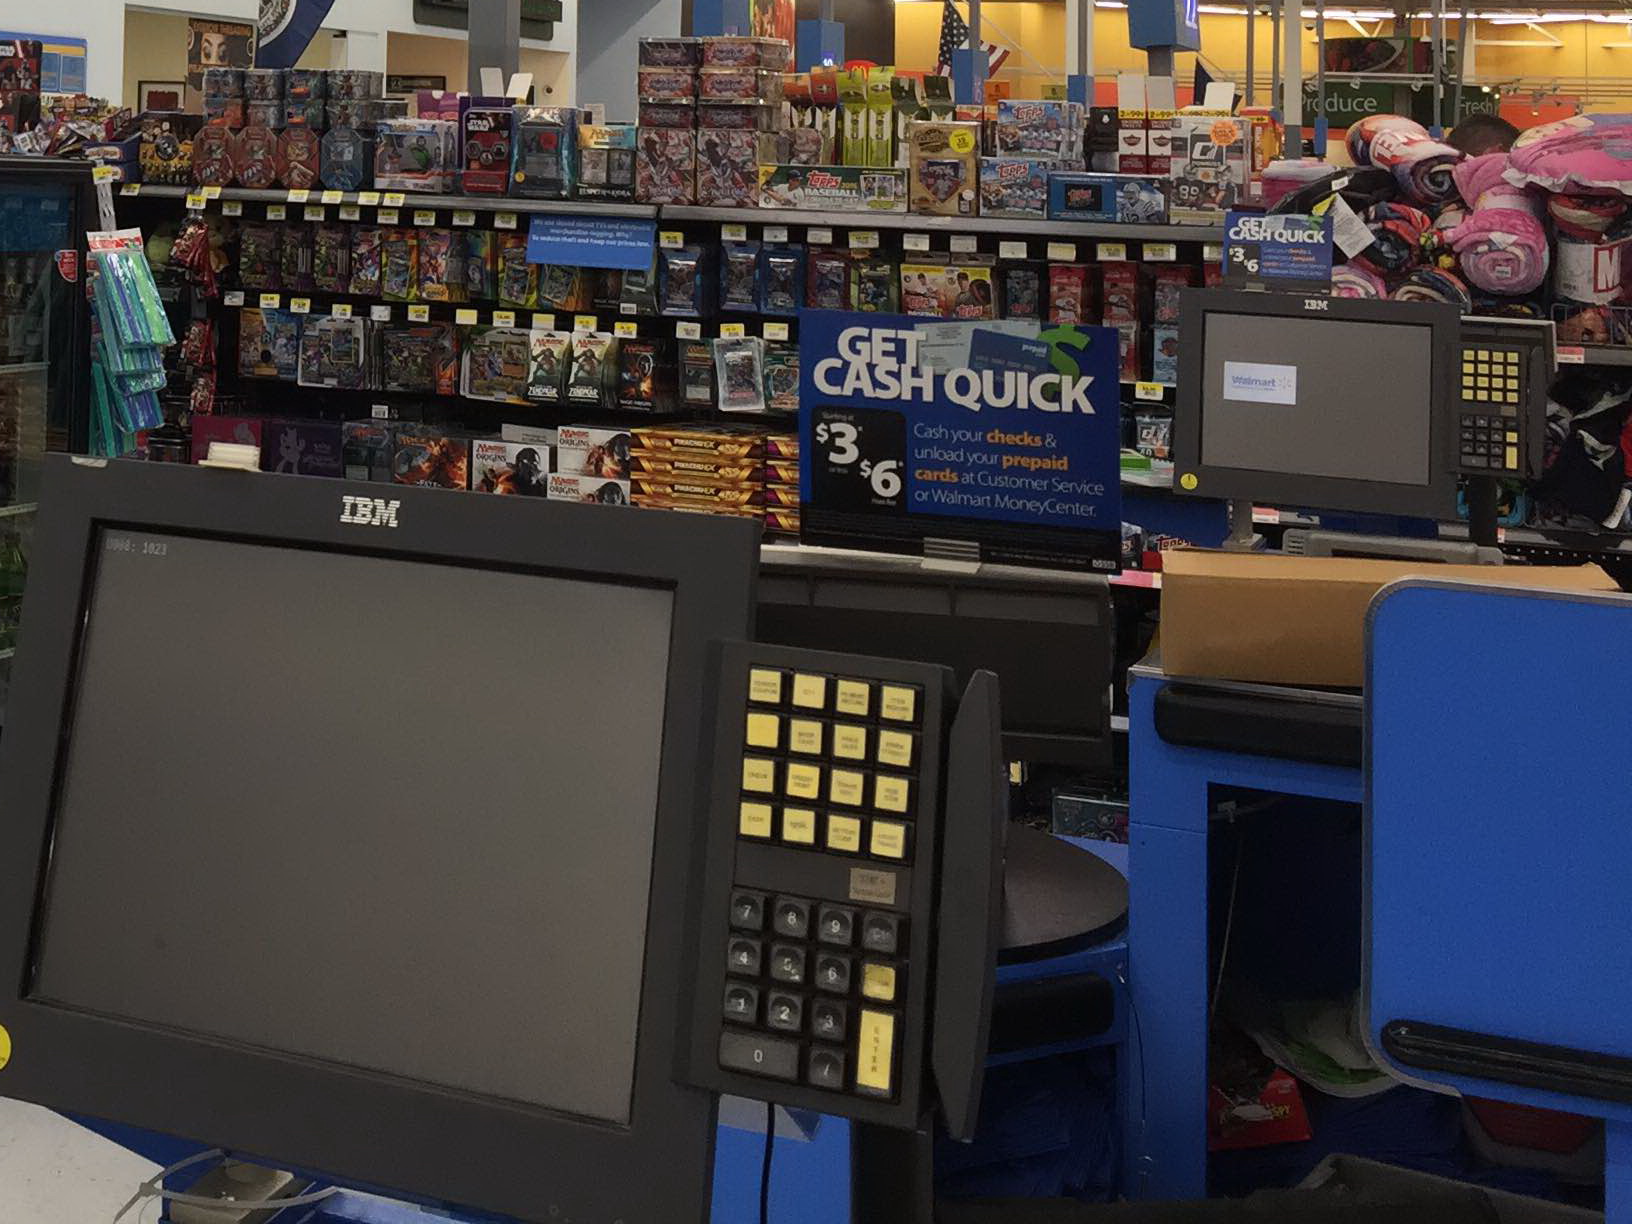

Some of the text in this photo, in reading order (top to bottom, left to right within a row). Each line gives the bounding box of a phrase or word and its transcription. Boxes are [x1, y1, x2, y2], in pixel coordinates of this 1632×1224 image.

[1229, 227, 1325, 244] CASH QUICK
[1237, 217, 1266, 231] GET
[1304, 298, 1328, 311] IBM
[837, 326, 927, 369] GET
[813, 357, 1096, 414] CASH QUICK
[1231, 375, 1276, 387] Walmart
[558, 438, 590, 447] ORIGINS
[914, 423, 1057, 449] Cash your checks &
[475, 453, 507, 463] ORIGINS
[914, 446, 1069, 472] unload your prepaid
[549, 486, 581, 495] ORIGINS
[914, 467, 1105, 497] cards at Customer Service
[339, 495, 401, 528] IBM
[914, 490, 930, 503] or
[931, 487, 992, 509] Walmart
[994, 493, 1097, 518] MoneyCenter.
[743, 904, 841, 933] 7 8 9
[738, 951, 837, 981] 4 5 6
[738, 997, 834, 1031] 1 2 3
[753, 1048, 763, 1063] 0
